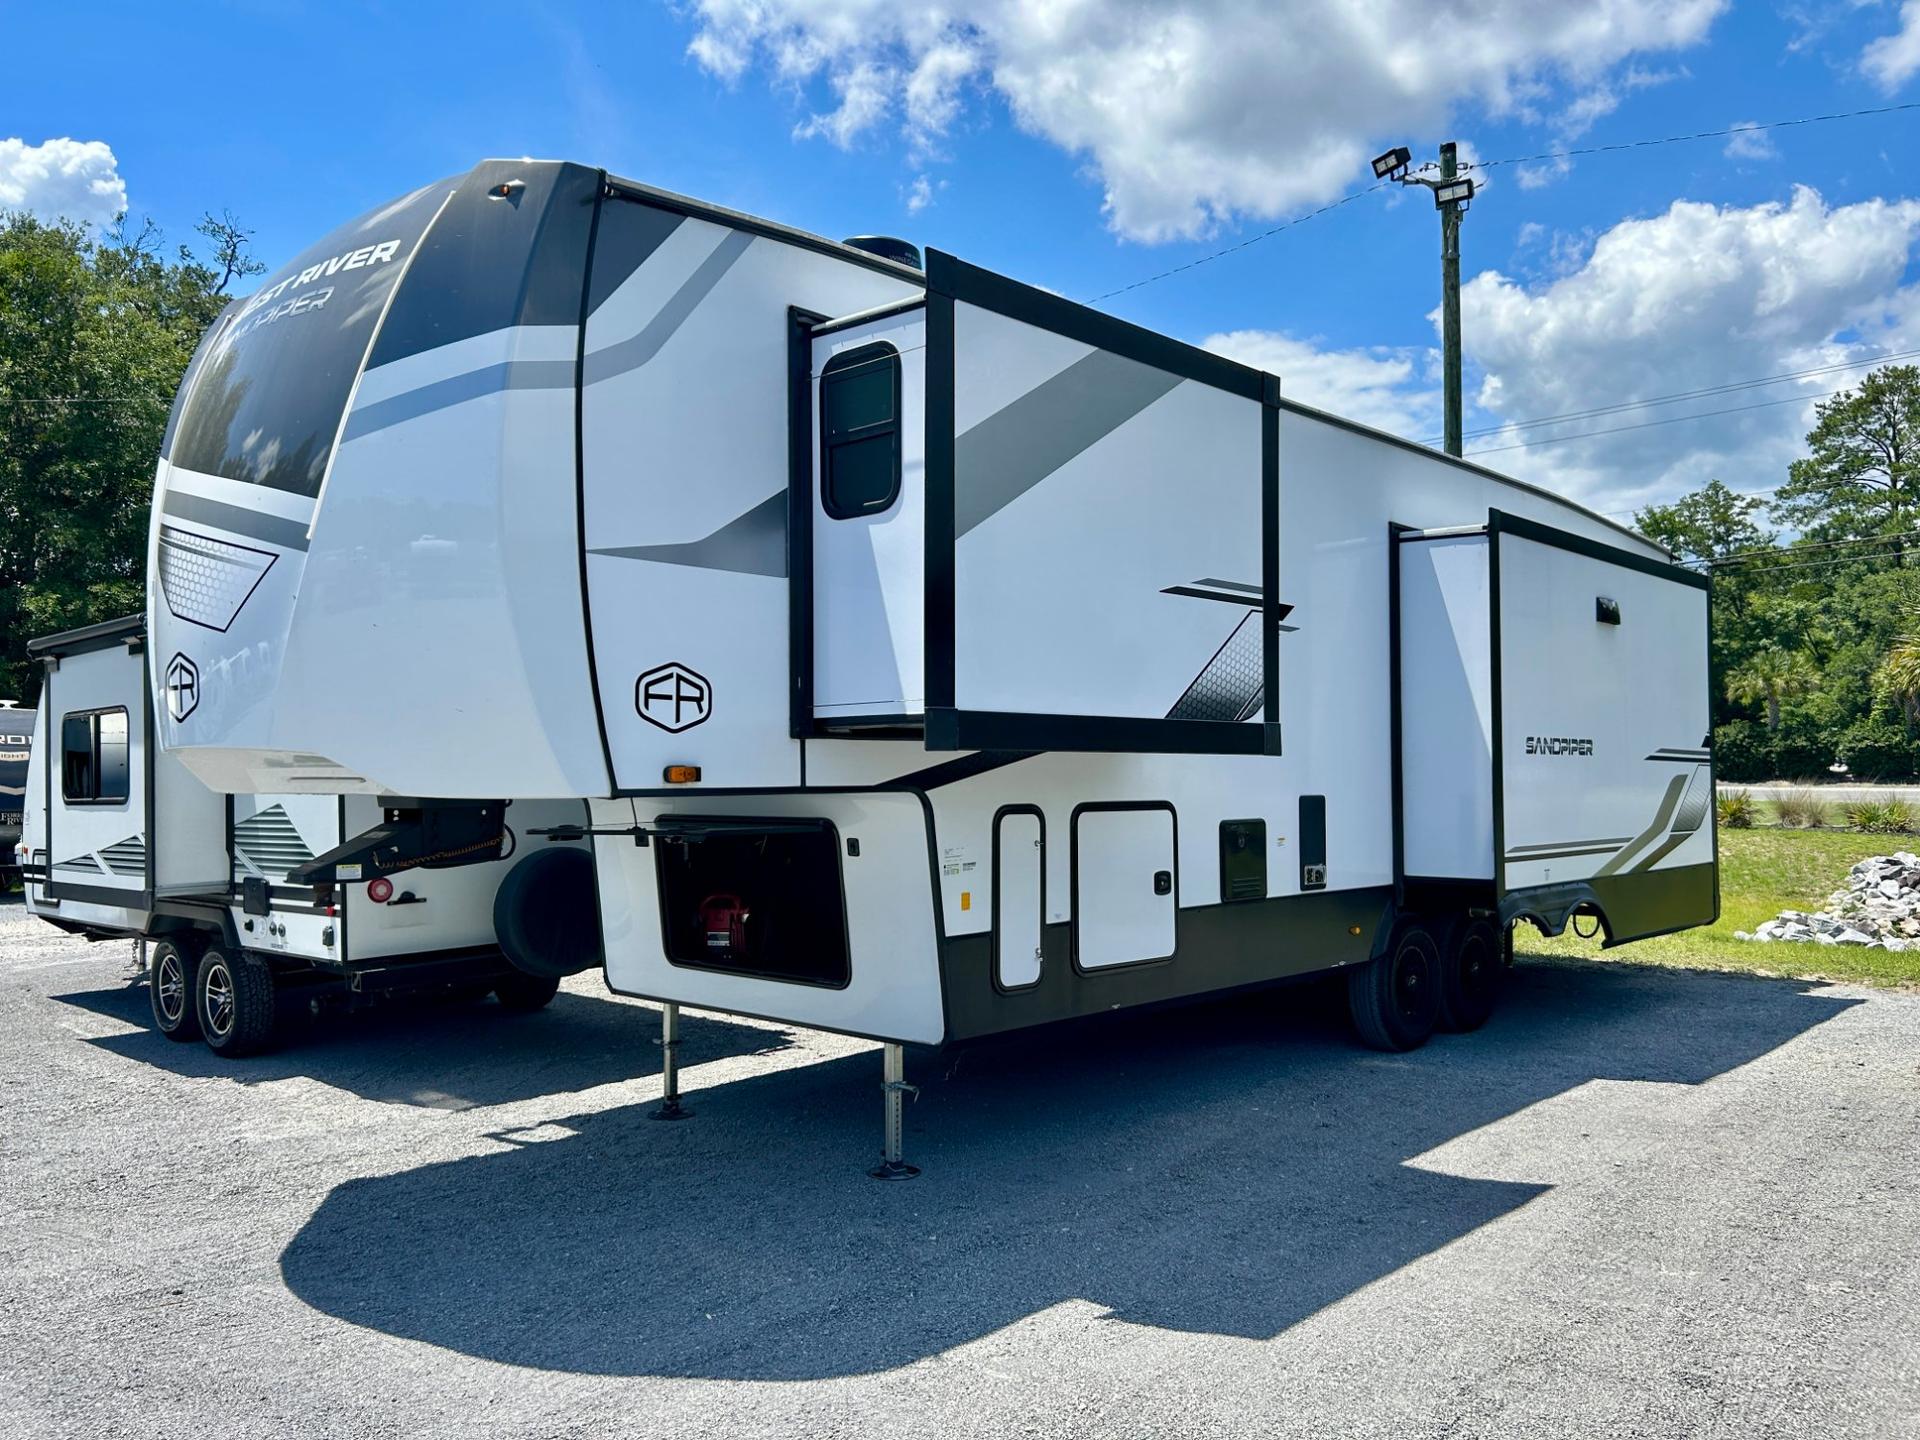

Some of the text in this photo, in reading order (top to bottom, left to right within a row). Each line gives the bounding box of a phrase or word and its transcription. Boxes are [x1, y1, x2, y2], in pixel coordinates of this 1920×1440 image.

[291, 239, 401, 289] RIVER
[644, 672, 705, 724] FR
[1525, 736, 1593, 756] SANDPIPER
